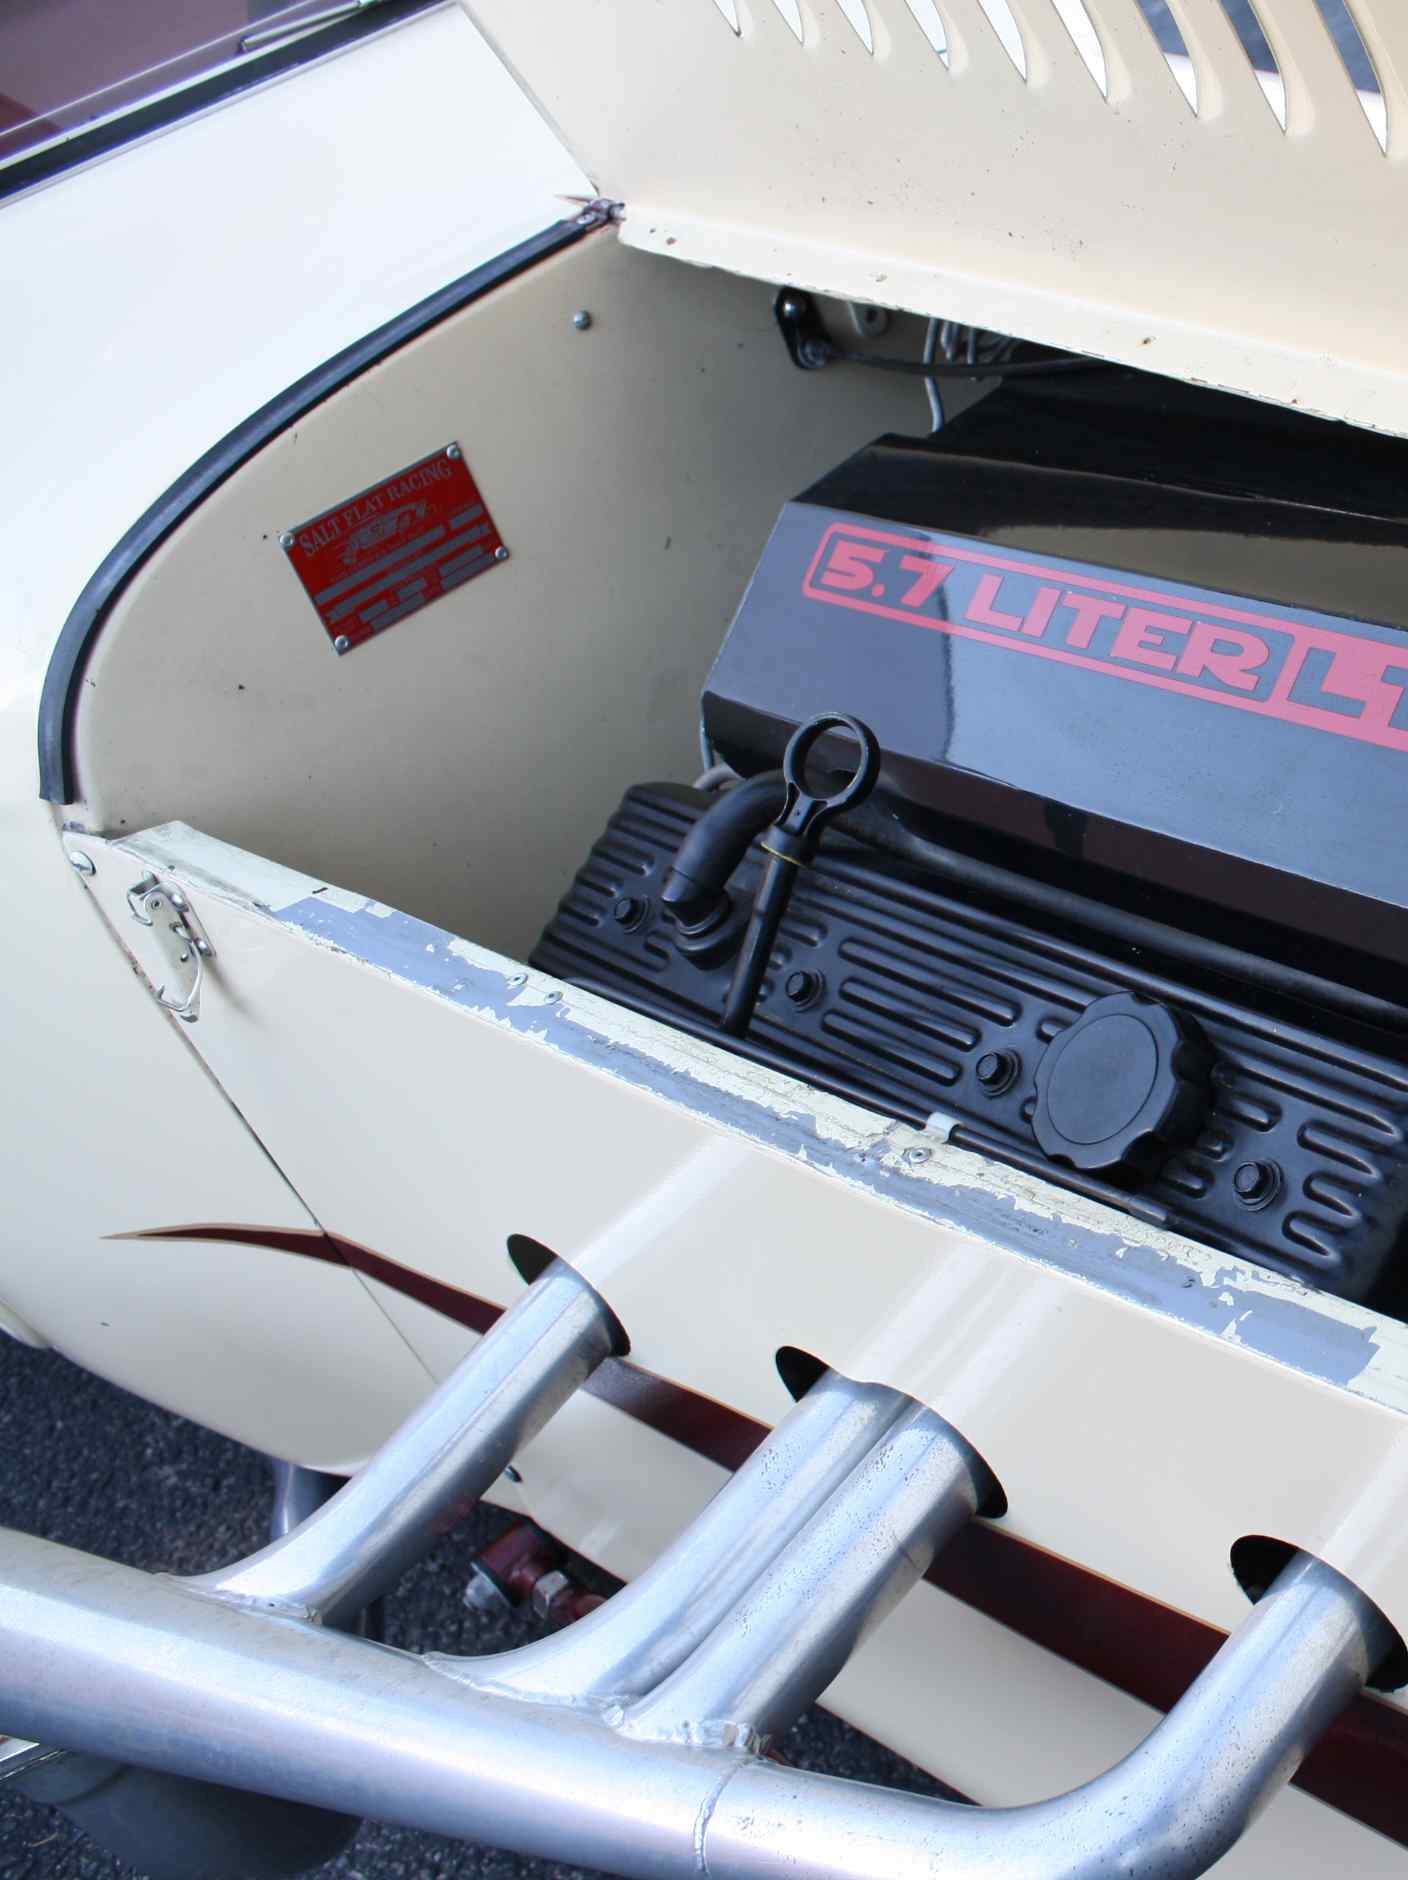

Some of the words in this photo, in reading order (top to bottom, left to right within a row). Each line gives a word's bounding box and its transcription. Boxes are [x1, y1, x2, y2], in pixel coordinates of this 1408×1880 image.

[299, 517, 341, 557] SALT
[343, 495, 385, 526] FLAT
[387, 459, 454, 500] RACING
[820, 540, 955, 608] 5.7
[964, 573, 1271, 692] LITER
